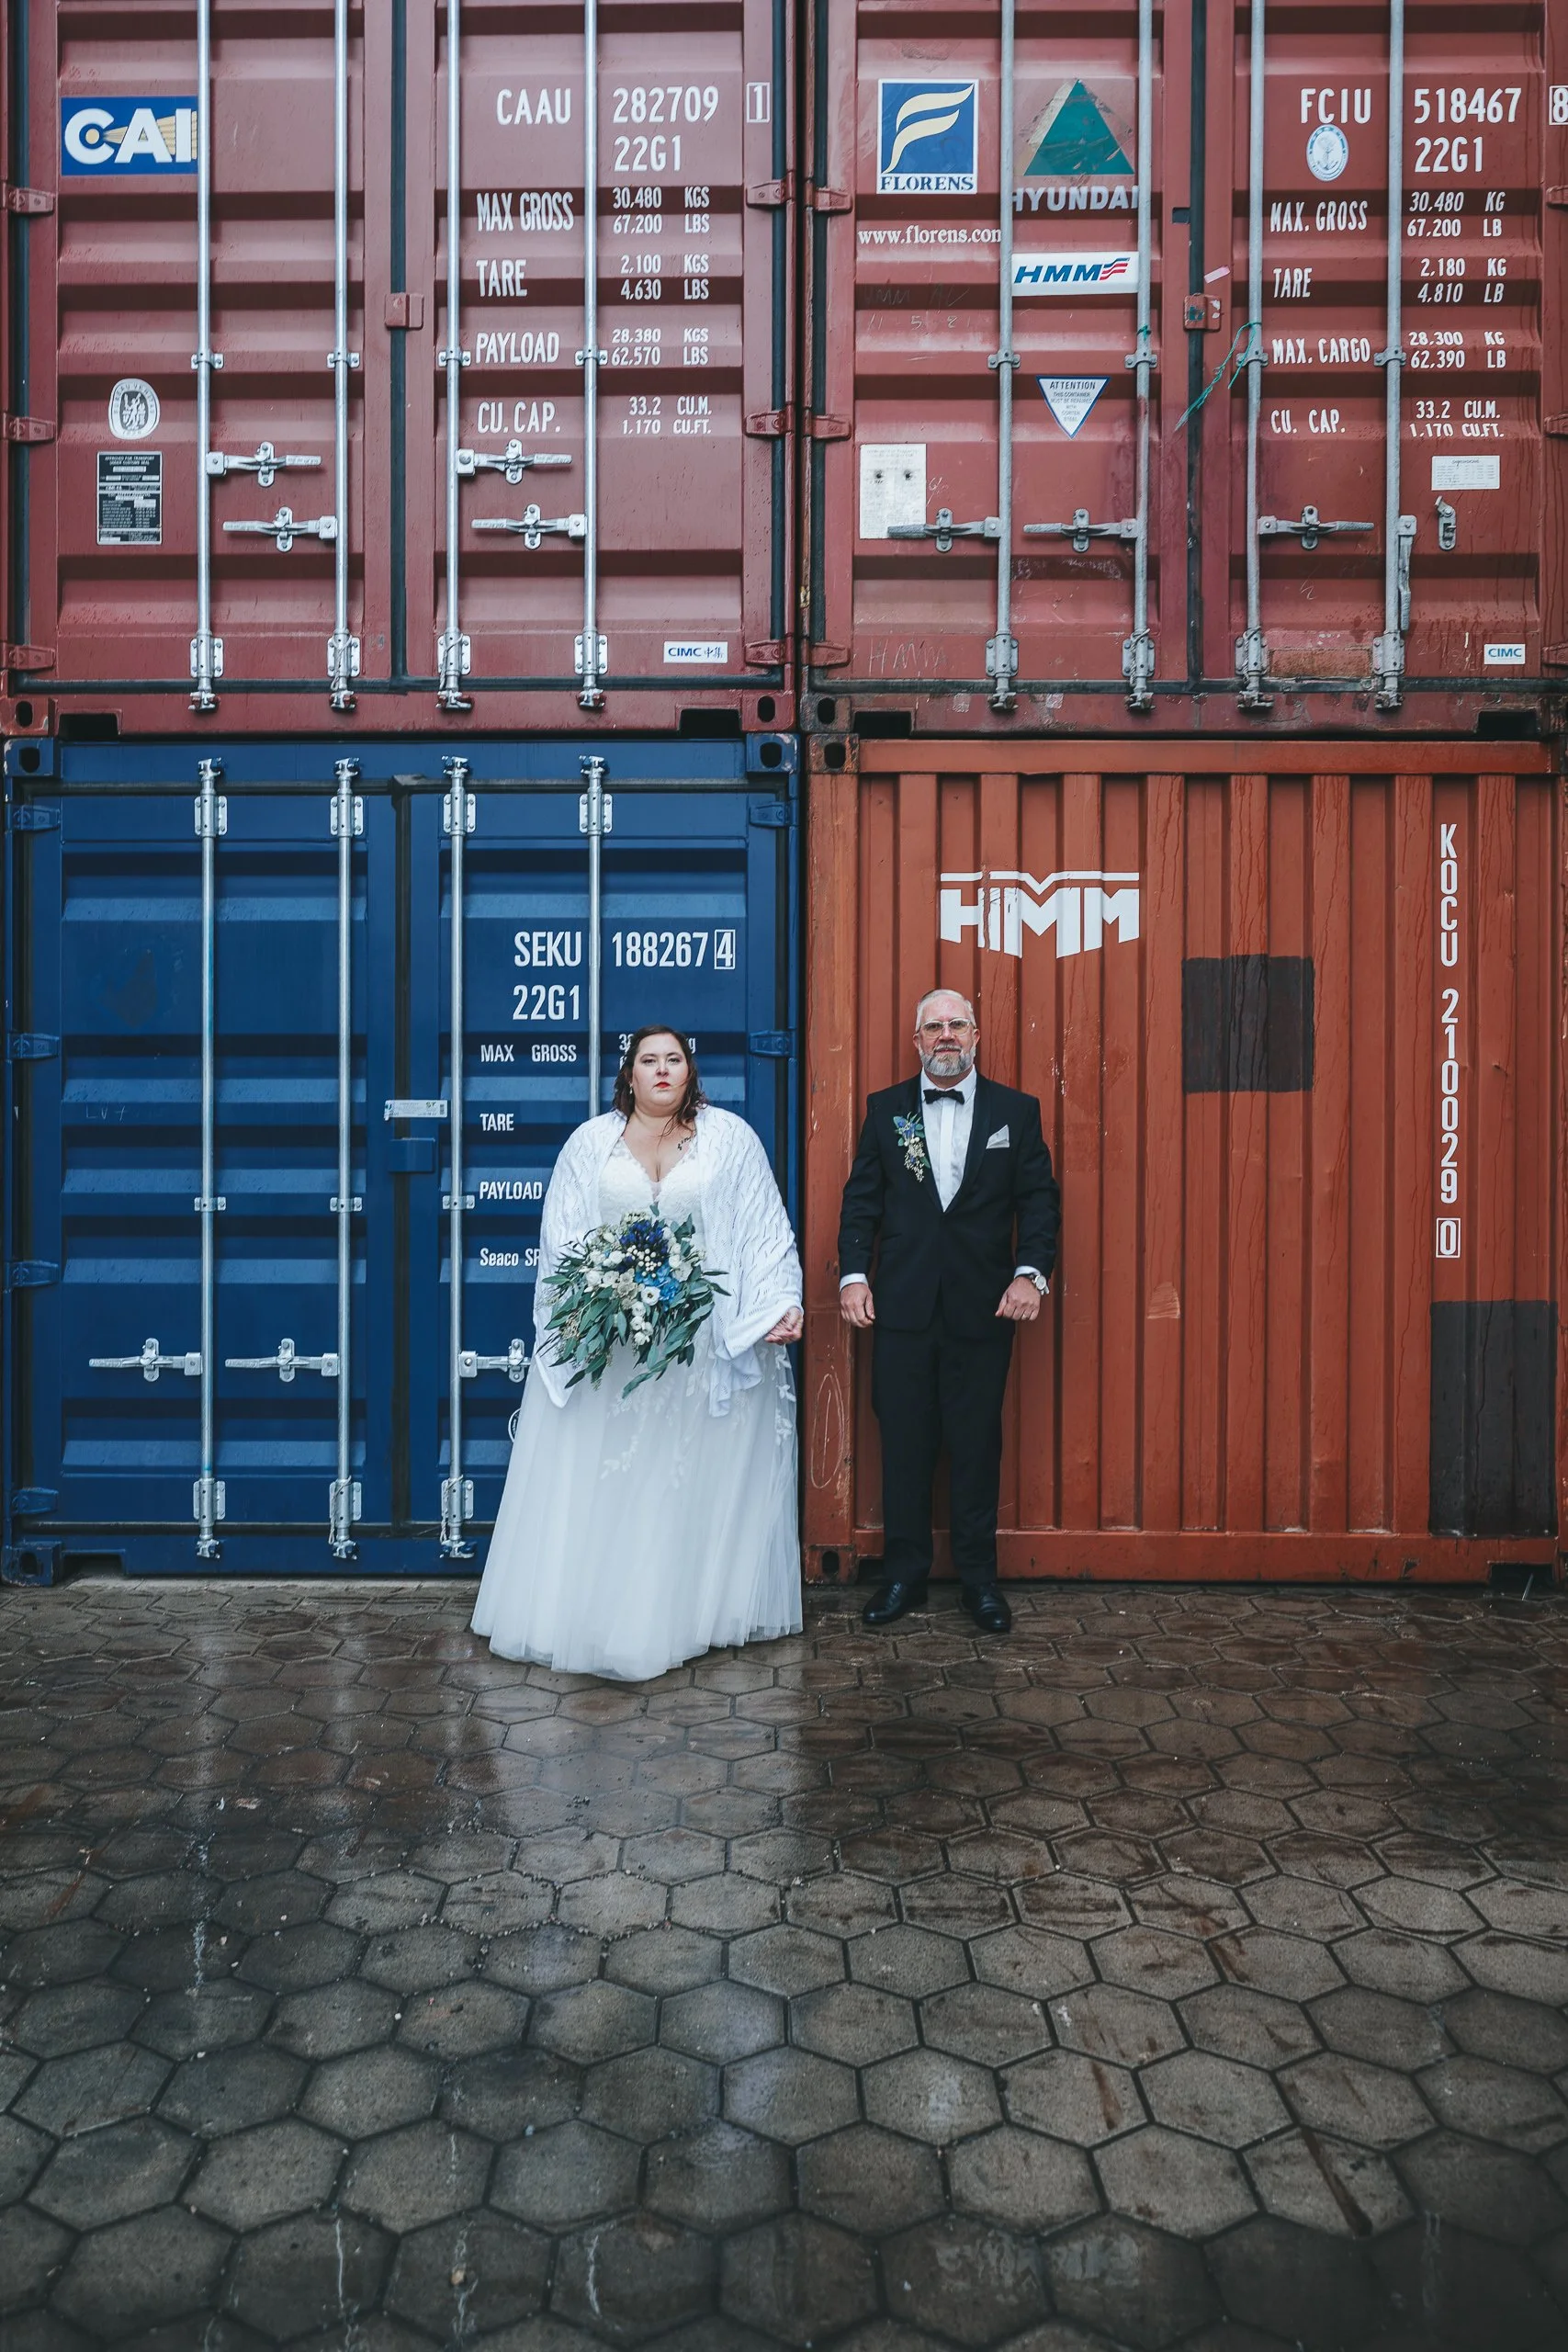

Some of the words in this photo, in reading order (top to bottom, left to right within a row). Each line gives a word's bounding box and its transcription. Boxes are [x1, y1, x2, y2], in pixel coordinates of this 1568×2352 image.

[496, 88, 571, 125] CAAU
[612, 86, 719, 124] 282709
[750, 84, 768, 121] 1
[1300, 88, 1372, 124] FCIU
[1413, 87, 1522, 124] 518467
[1551, 86, 1568, 124] 8
[64, 107, 192, 165] CAI
[614, 134, 682, 172] 22G1
[1414, 136, 1483, 173] 22G1
[880, 175, 974, 191] FLORENS
[684, 187, 710, 209] KGS
[1484, 191, 1506, 212] KG
[477, 193, 513, 232] MAX
[520, 192, 574, 232] GROSS
[1269, 201, 1309, 233] MAX.
[1315, 200, 1368, 231] GROSS
[684, 214, 710, 234] LBS
[1483, 219, 1503, 237] LB
[683, 254, 710, 274] KGS
[1013, 264, 1102, 284] HMM
[1487, 258, 1506, 277] KG
[476, 259, 528, 298] TARE
[683, 278, 710, 300] LBS
[1272, 267, 1313, 299] TARE
[1483, 283, 1505, 303] LB
[683, 328, 709, 343] KGS
[1483, 331, 1505, 345] KG
[475, 332, 560, 364] PAYLOAD
[682, 345, 709, 366] LBS
[1272, 338, 1314, 365] MAX.
[1317, 337, 1371, 364] CARGO
[1487, 350, 1506, 368] LB
[1049, 380, 1096, 390] ATTENTION
[628, 396, 661, 416] 33.2
[1416, 401, 1450, 420] 33.2
[477, 401, 509, 435] CU.
[514, 401, 561, 434] CAP.
[1270, 410, 1298, 435] CU.
[1308, 409, 1346, 434] CAP.
[668, 648, 702, 657] CIMC
[1488, 648, 1522, 658] CIMC
[1440, 823, 1458, 967] KOCU
[513, 931, 581, 967] SEKU
[611, 931, 708, 967] 188267
[716, 931, 734, 968] 4
[513, 984, 581, 1021] 22G1
[480, 1045, 514, 1063] MAX
[531, 1045, 577, 1063] GROSS
[1440, 988, 1460, 1204] 210029
[479, 1113, 514, 1132] TARE
[479, 1182, 543, 1201] PAYLOAD
[479, 1248, 519, 1266] Seaco
